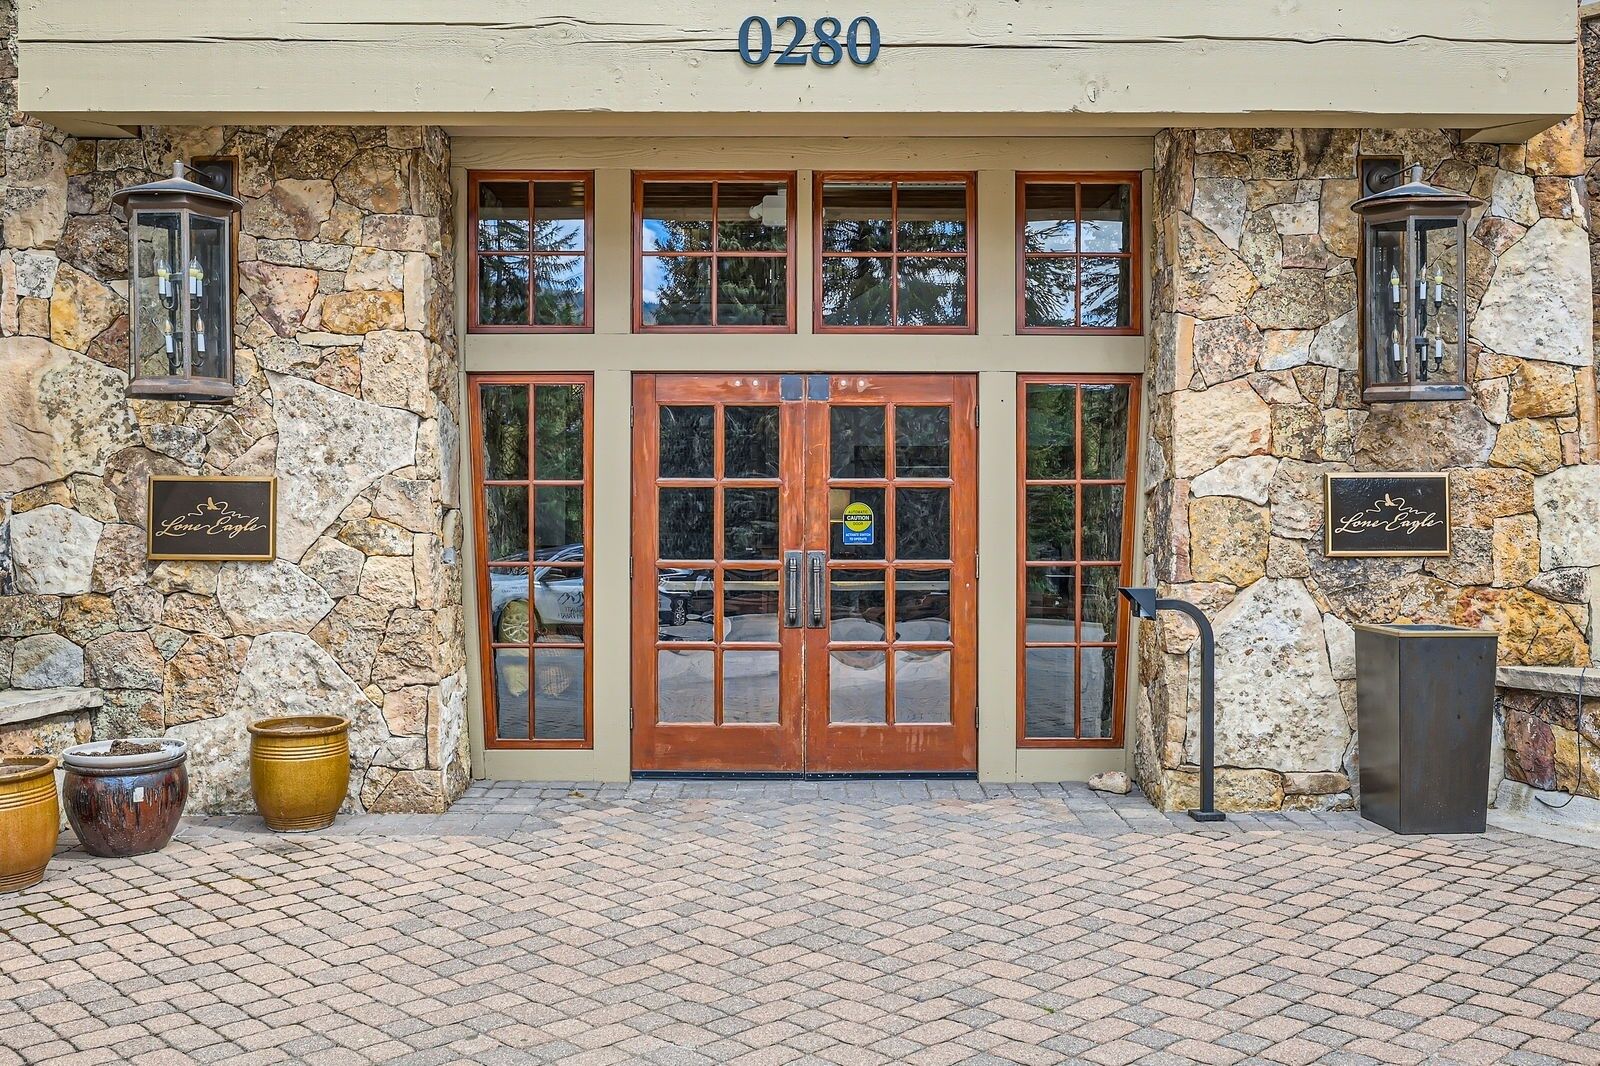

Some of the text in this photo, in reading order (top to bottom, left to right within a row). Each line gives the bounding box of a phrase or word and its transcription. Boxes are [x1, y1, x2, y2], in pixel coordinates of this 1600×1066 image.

[738, 15, 881, 66] 0280
[155, 515, 267, 539] Lone Eagle
[1334, 512, 1444, 535] Lone Eagle
